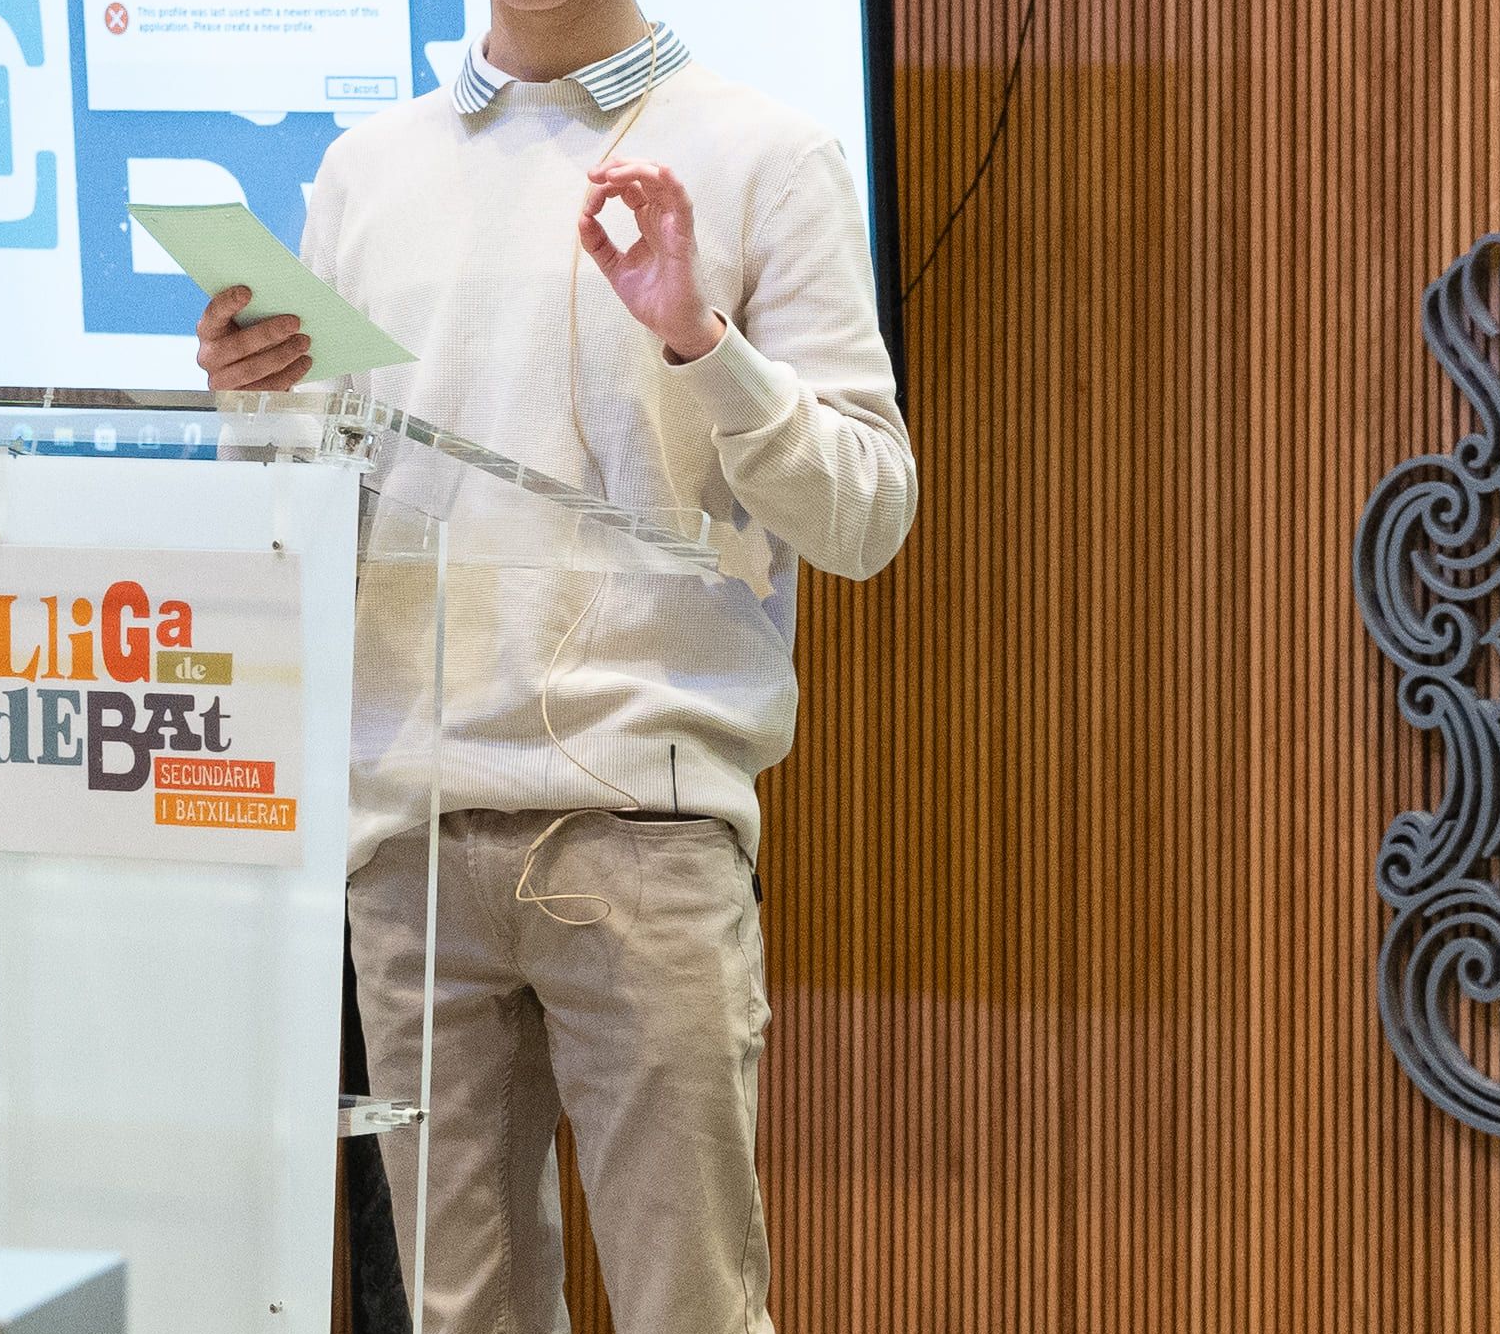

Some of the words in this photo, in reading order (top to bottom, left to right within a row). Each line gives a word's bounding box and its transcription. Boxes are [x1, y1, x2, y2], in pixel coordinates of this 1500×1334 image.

[175, 656, 207, 681] de
[161, 798, 168, 820] I
[175, 798, 290, 827] BATXILLERAT
